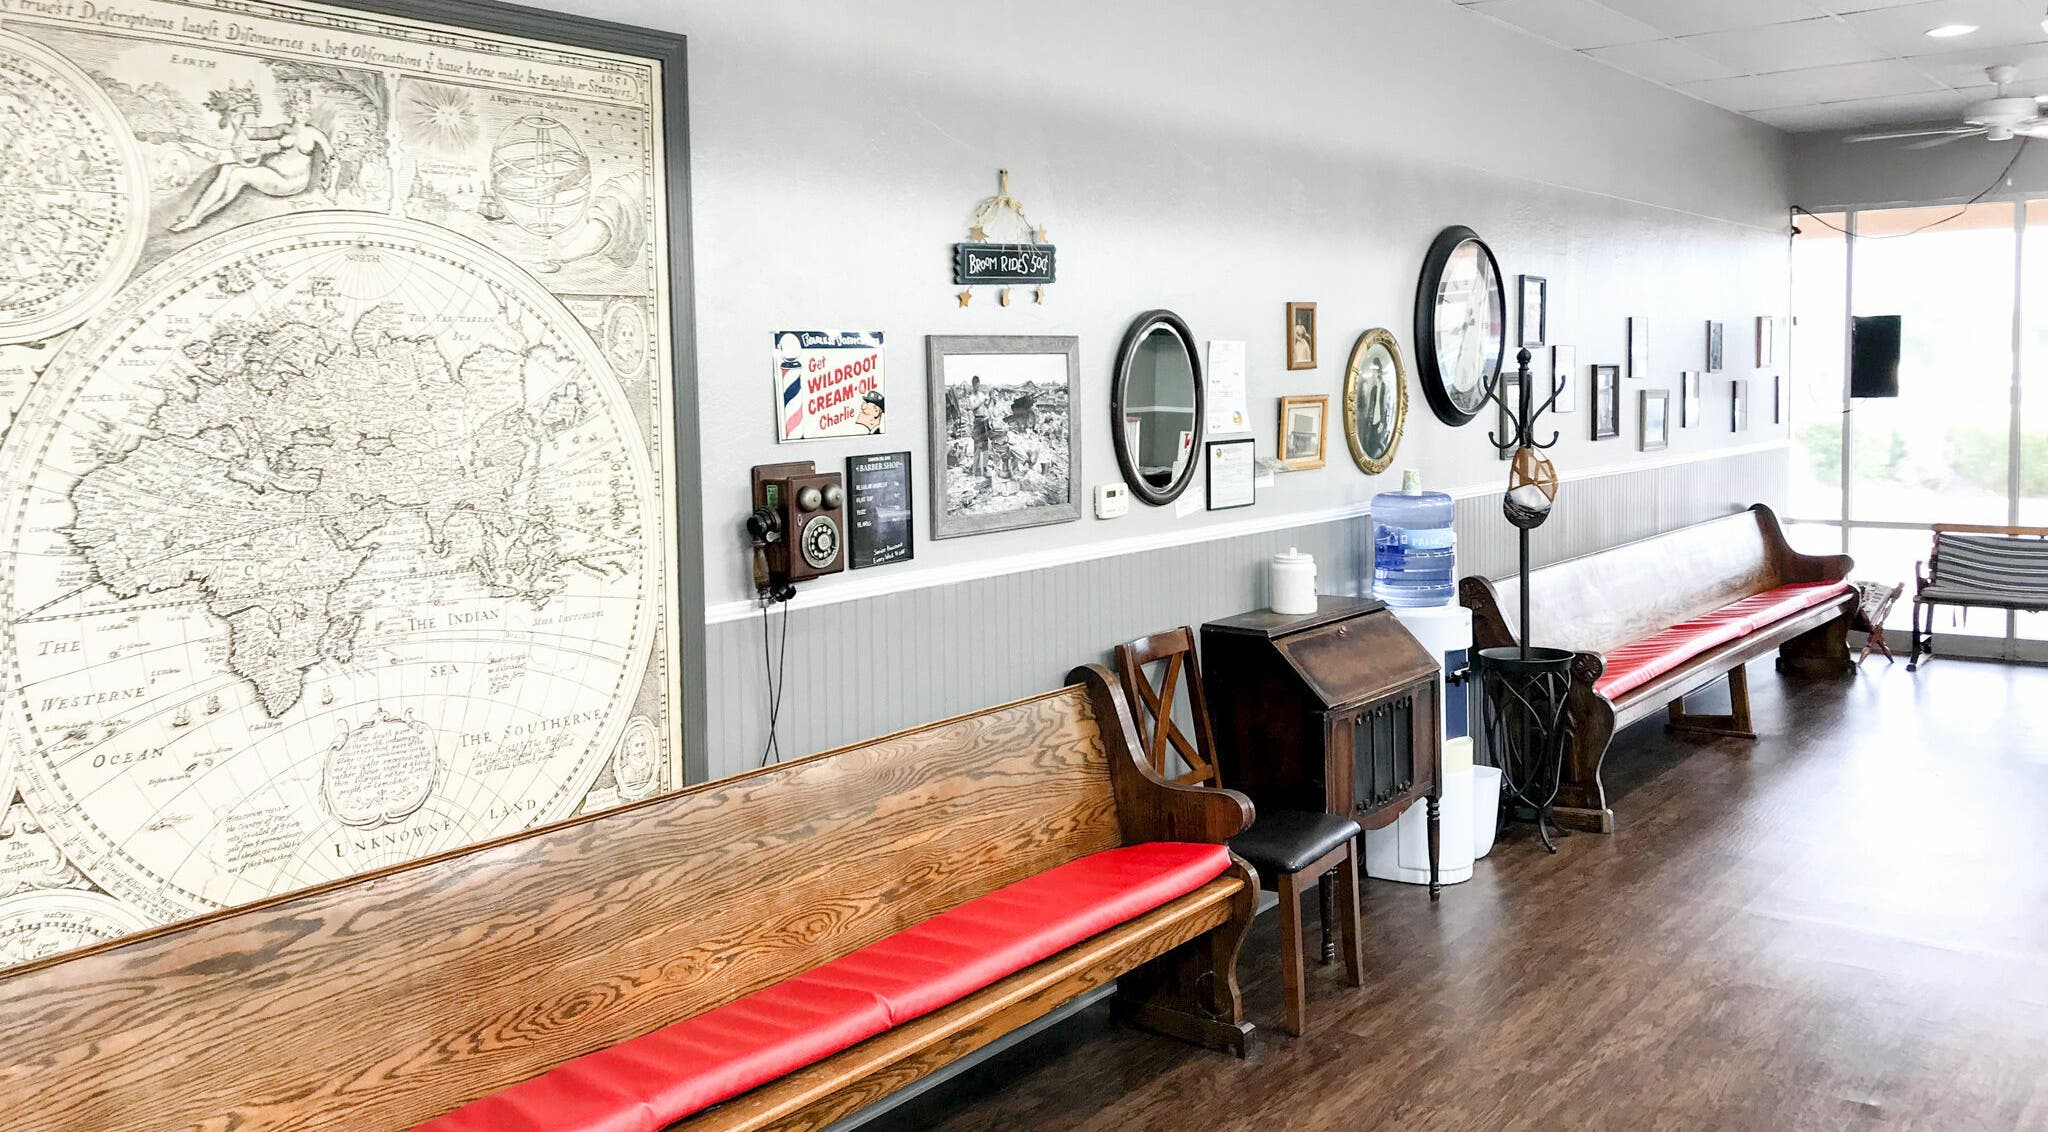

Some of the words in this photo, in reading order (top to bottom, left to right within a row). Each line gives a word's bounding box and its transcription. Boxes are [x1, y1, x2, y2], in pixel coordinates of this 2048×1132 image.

[968, 253, 998, 274] BROOM
[1000, 253, 1029, 275] RIDES
[807, 353, 878, 394] WILDROOT
[808, 355, 826, 373] Get
[819, 405, 855, 430] Charlie
[859, 463, 882, 472] BARBER
[407, 617, 436, 631] THE
[448, 608, 500, 626] INDIAN
[38, 640, 81, 656] THE
[430, 663, 459, 678] SEA
[41, 686, 145, 713] WESTERNE
[458, 731, 493, 748] THE
[504, 708, 602, 739] SOUTHERNE
[93, 747, 164, 768] OCEAN
[335, 818, 452, 859] UNKNOWNE
[489, 798, 537, 820] LAND
